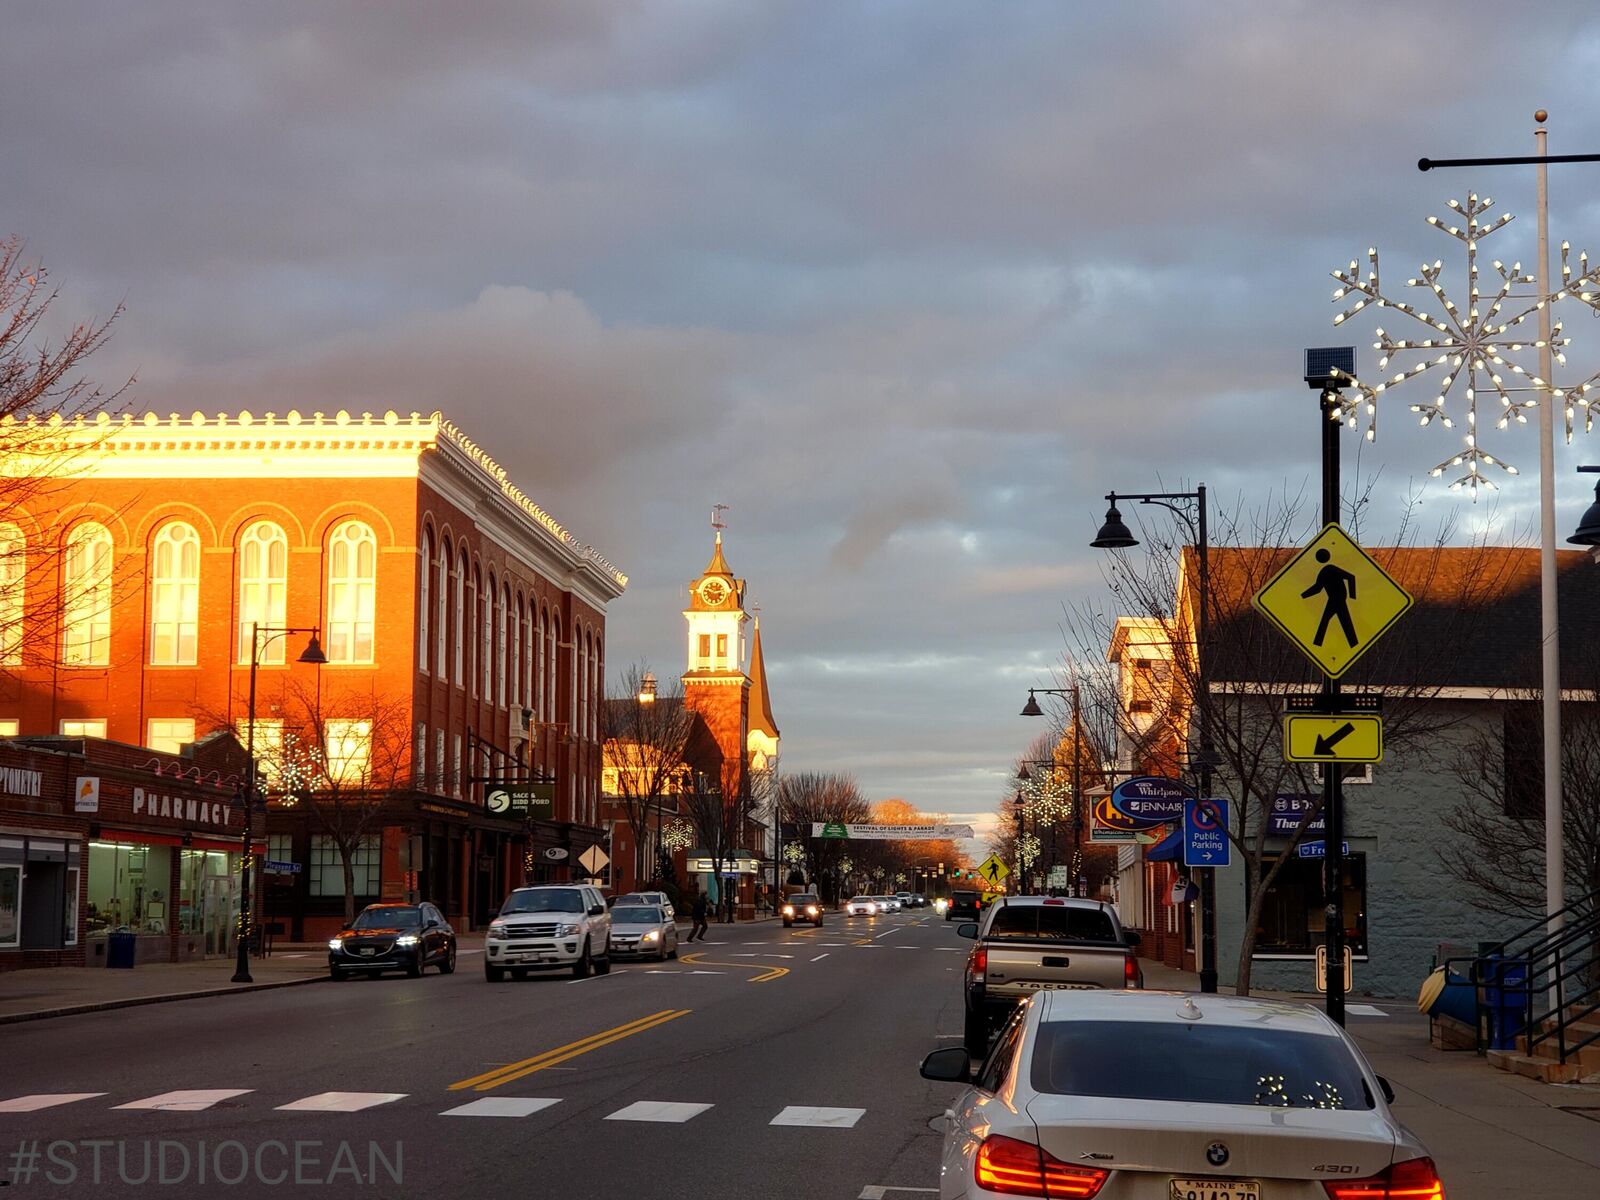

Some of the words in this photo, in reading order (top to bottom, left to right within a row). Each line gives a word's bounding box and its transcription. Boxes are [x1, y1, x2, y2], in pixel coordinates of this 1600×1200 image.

[133, 787, 230, 825] PHARMACY
[1140, 802, 1182, 813] JENN-AIR
[1194, 832, 1220, 841] Public
[1191, 841, 1223, 851] Parking
[1016, 982, 1095, 990] TACOMA
